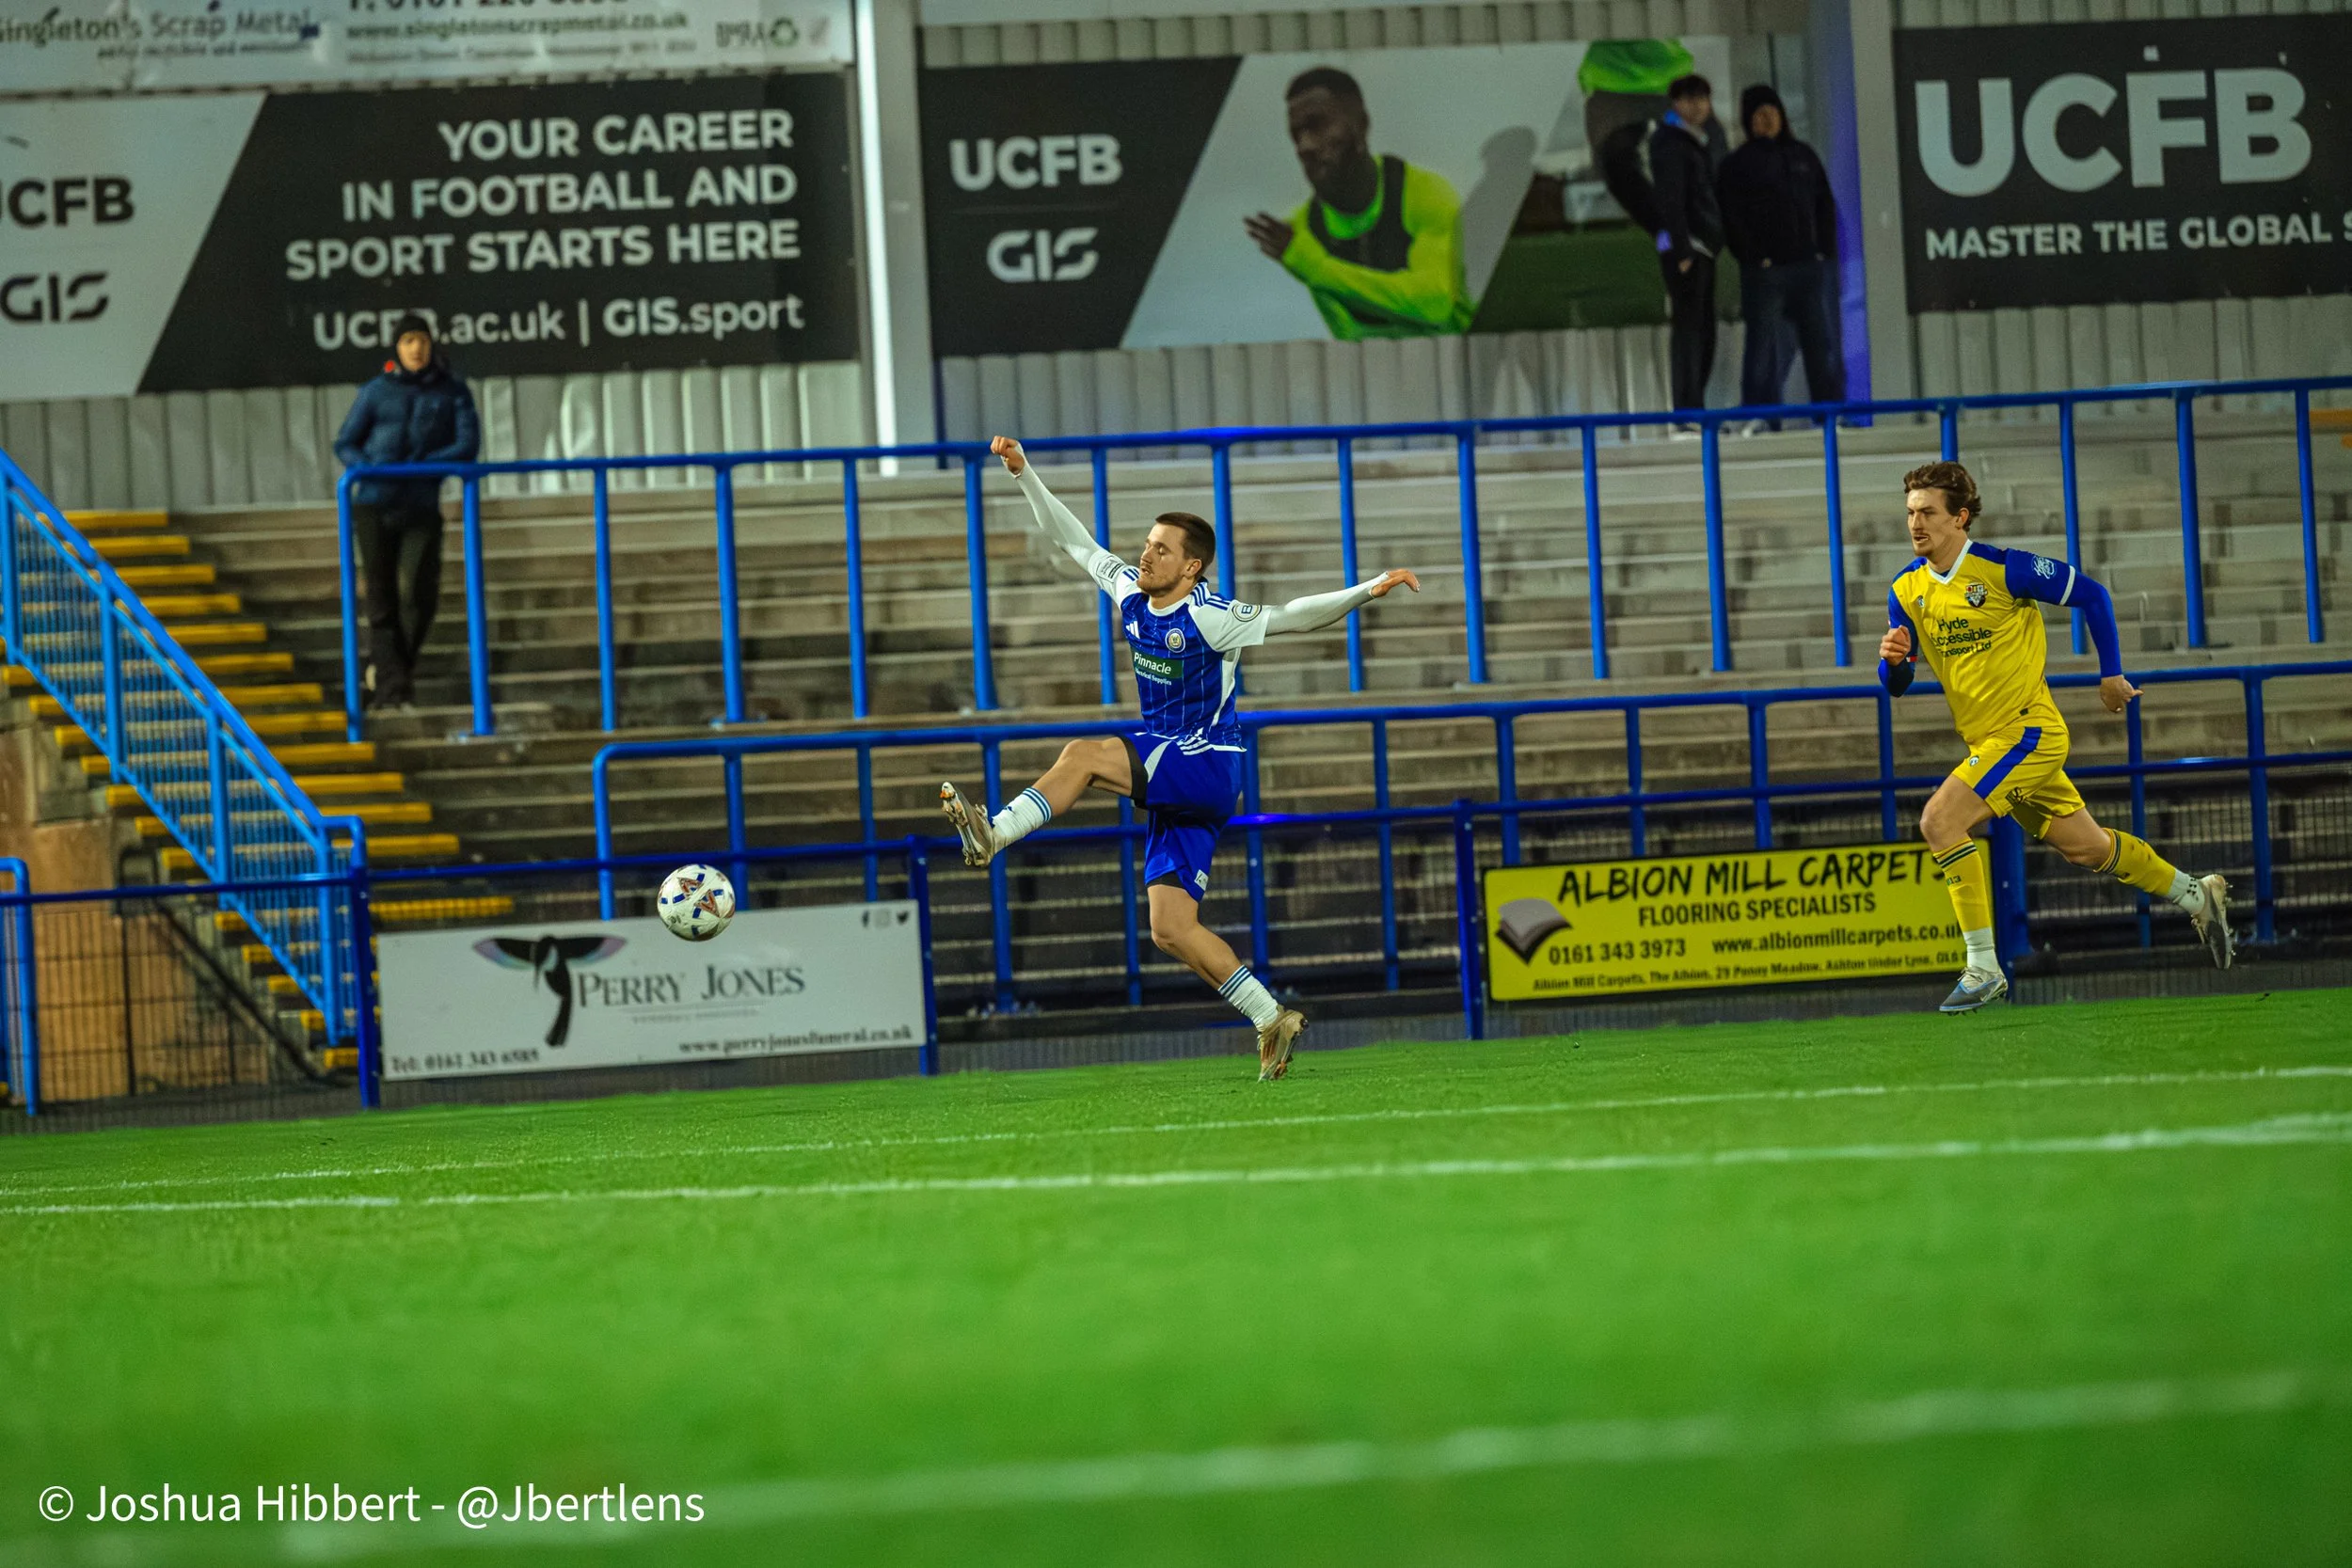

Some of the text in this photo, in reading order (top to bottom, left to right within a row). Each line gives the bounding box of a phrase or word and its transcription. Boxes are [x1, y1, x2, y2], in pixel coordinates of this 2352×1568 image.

[150, 10, 227, 40] Scrap
[236, 8, 310, 34] Metal
[438, 109, 793, 161] YOUR CAREER
[1914, 68, 2312, 197] UCFB
[949, 134, 1122, 190] UCFB
[0, 176, 134, 228] CFB
[342, 166, 798, 222] IN FOOTBALL AND
[286, 221, 802, 280] SPORT STARTS HERE
[987, 228, 1099, 281] GIS
[1926, 222, 2082, 261] MASTER
[2093, 219, 2169, 253] THE
[2180, 213, 2332, 248] GLOBAL
[0, 271, 109, 323] GIS
[603, 296, 805, 340] GIS.sport
[1937, 617, 1969, 633] Hyde
[1937, 640, 1992, 657] nsport Ltd
[1134, 652, 1171, 674] Pinnacle
[1558, 866, 1692, 907] ALBION
[1705, 859, 1787, 895] MILL
[1639, 892, 1876, 928] FLOORING SPECIALISTS
[1549, 944, 1594, 966] 0161
[1600, 942, 1635, 961] 343
[1641, 940, 1687, 958] 3973
[1650, 971, 1670, 983] The
[1716, 966, 1730, 979] 29
[1733, 964, 1768, 979] Penny
[1825, 958, 1866, 971] Ashton
[1867, 954, 1902, 968] Under
[579, 964, 806, 1007] PERRY JONES
